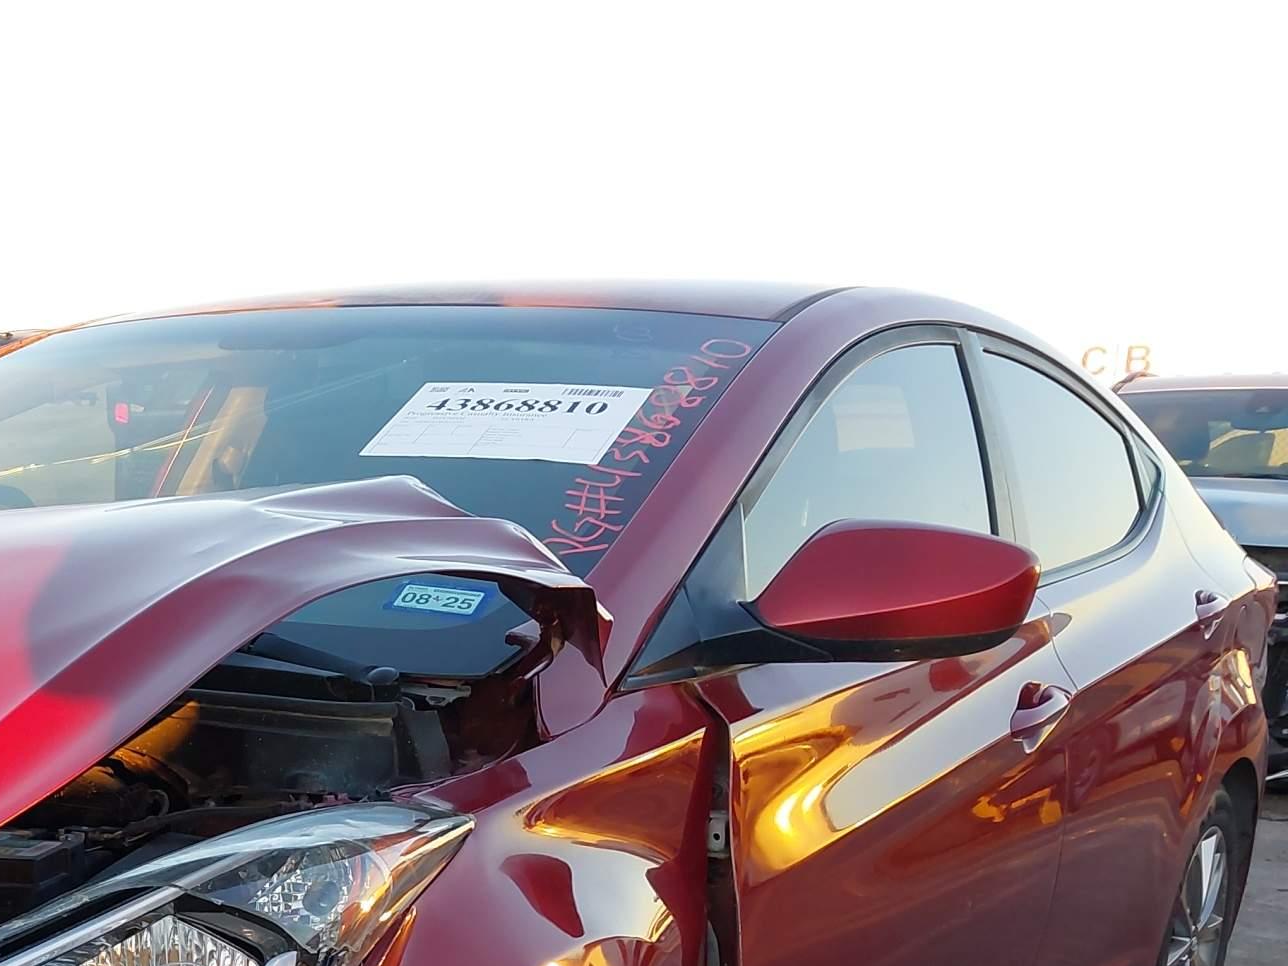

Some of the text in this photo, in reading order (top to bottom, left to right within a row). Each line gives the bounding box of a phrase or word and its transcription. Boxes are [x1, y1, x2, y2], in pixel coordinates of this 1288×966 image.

[425, 398, 609, 415] 43868810
[401, 592, 432, 605] 08
[441, 596, 475, 610] 25
